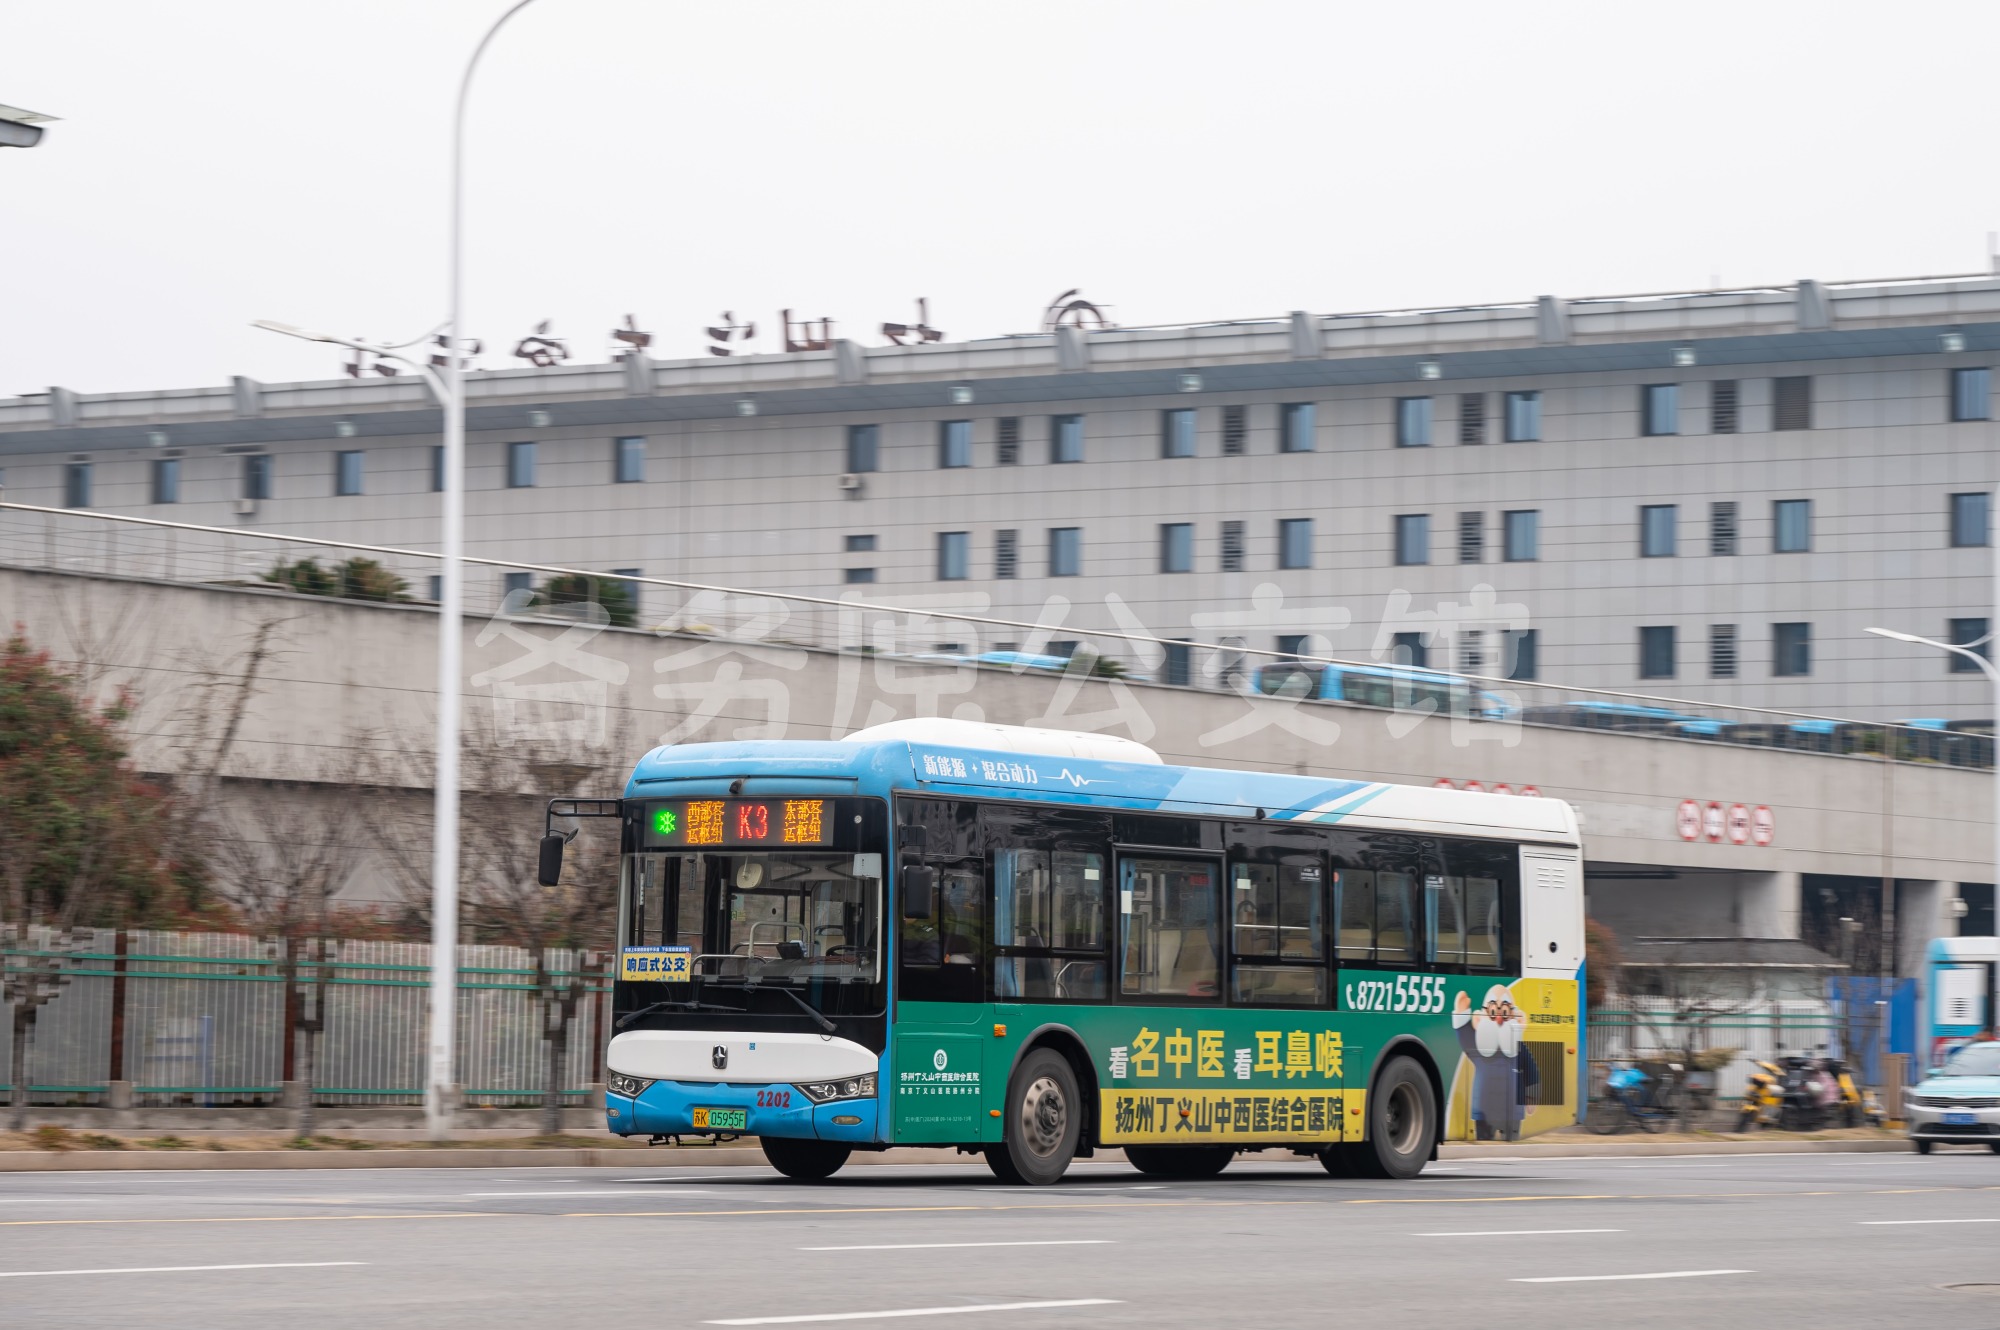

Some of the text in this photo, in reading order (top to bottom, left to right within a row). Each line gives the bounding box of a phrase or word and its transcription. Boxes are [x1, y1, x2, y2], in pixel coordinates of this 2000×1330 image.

[923, 754, 967, 778] 新能源
[981, 760, 1038, 784] 混合动力
[740, 805, 767, 838] K3
[626, 957, 686, 972] 响应式公交
[1356, 974, 1447, 1013] 87215555
[900, 1072, 980, 1082] 扬州丁义山中西医结合医院
[756, 1090, 791, 1109] 2202
[1115, 1096, 1344, 1133] 扬州丁义山中西医结合医院
